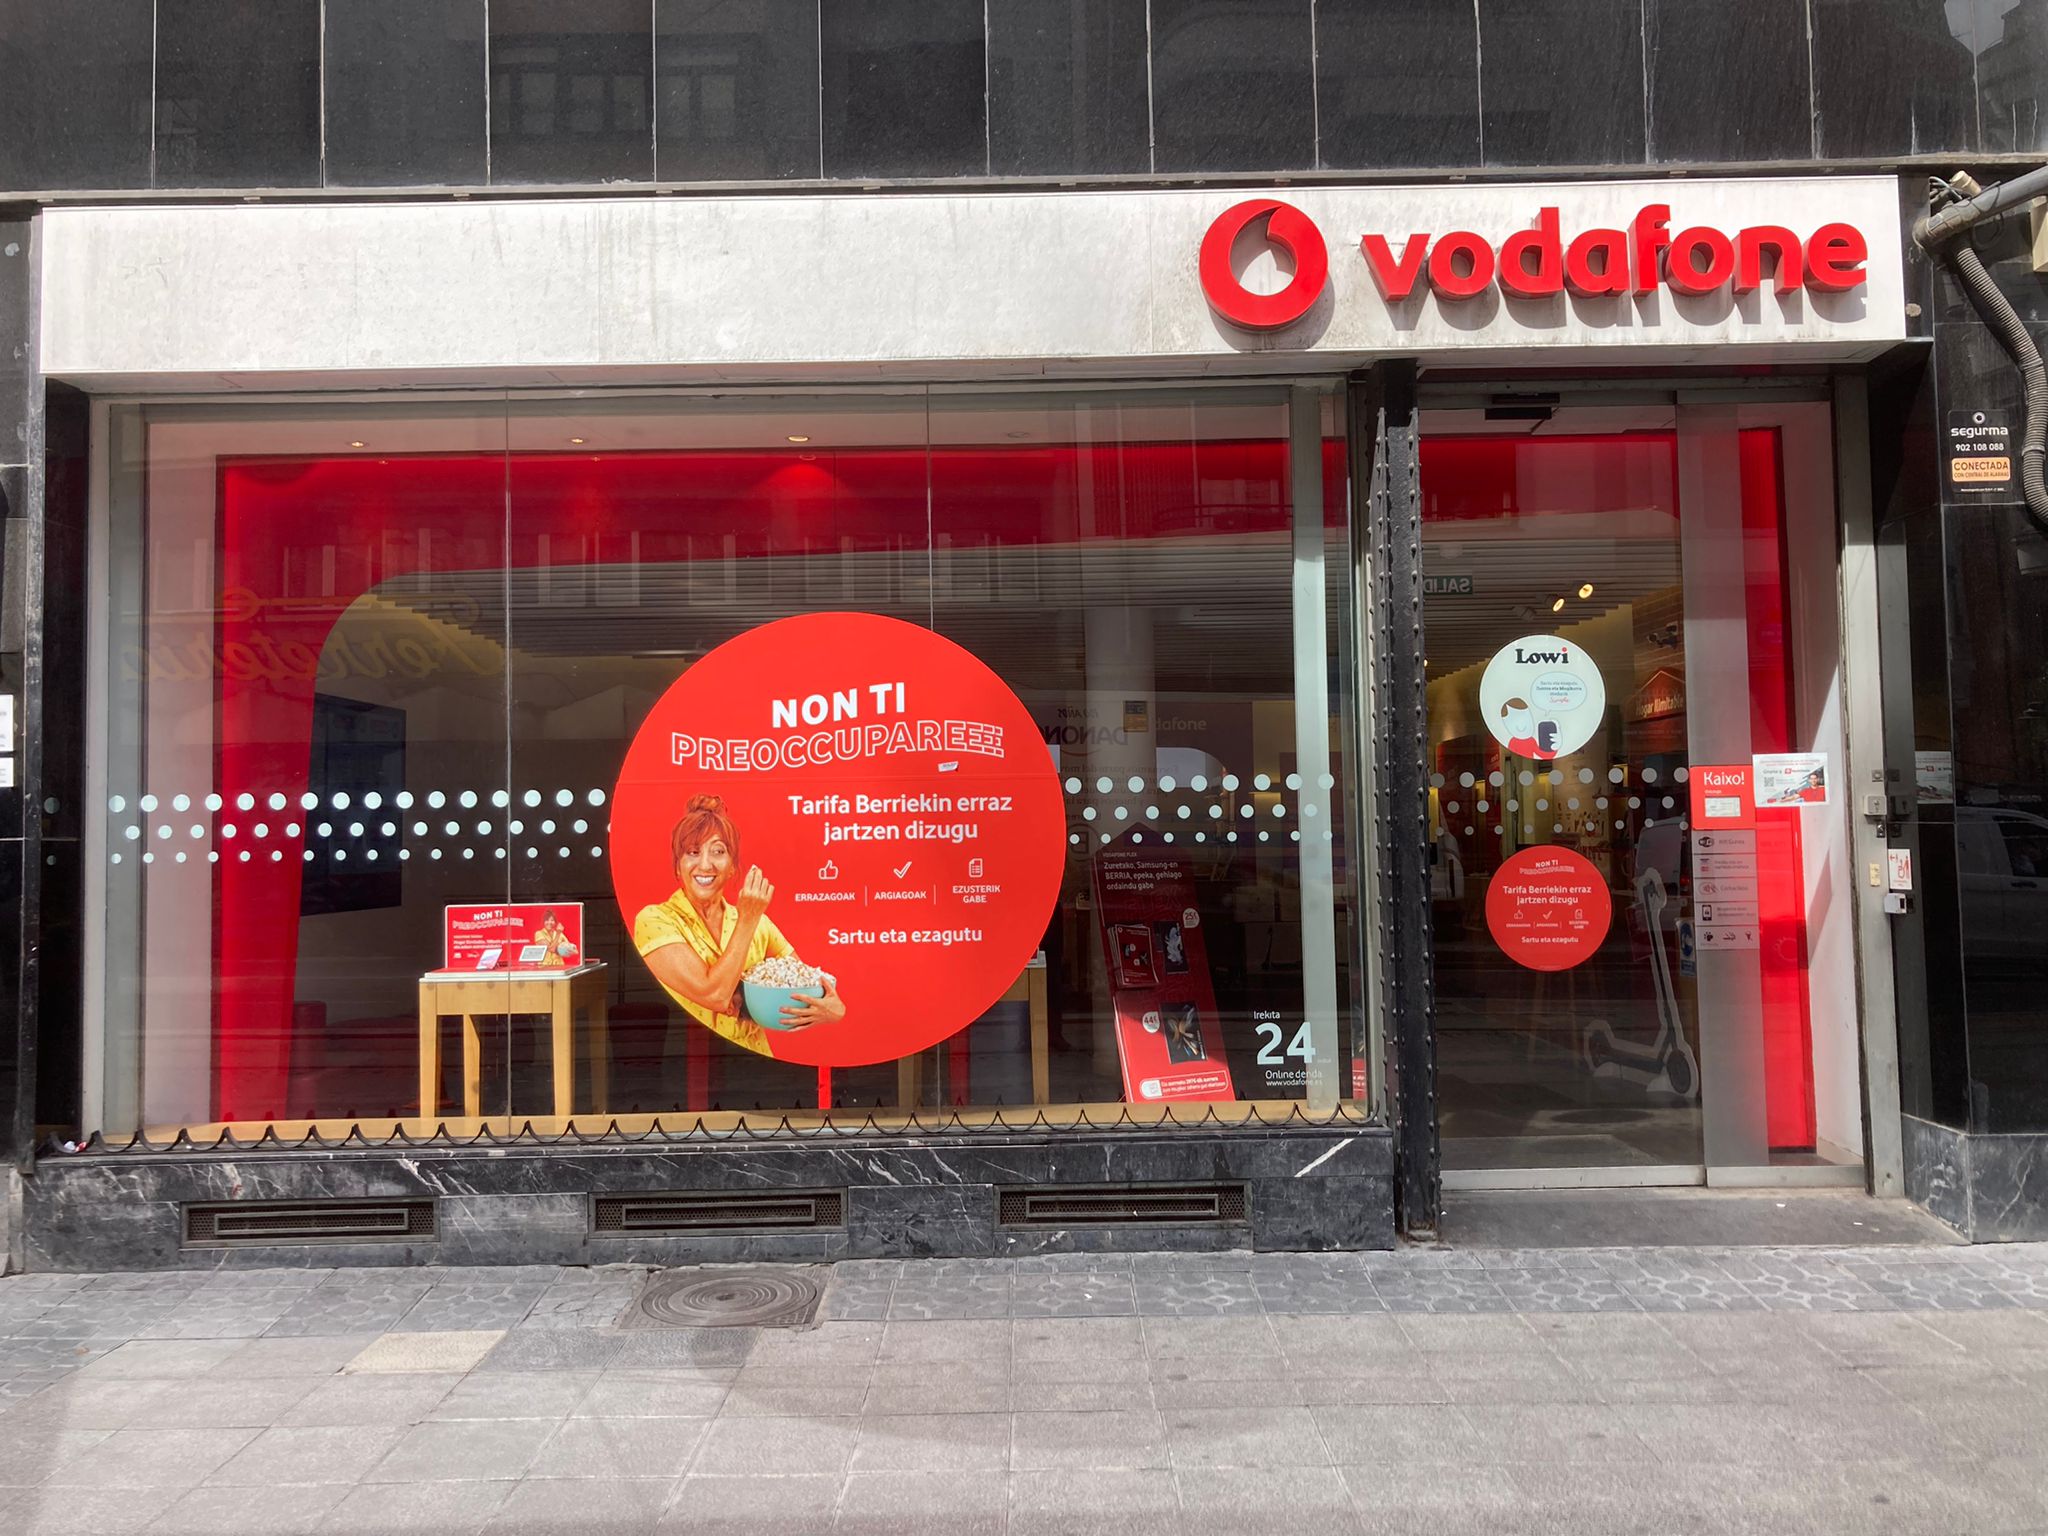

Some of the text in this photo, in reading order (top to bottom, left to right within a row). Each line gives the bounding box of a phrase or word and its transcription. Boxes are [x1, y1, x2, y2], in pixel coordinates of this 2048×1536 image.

[1361, 203, 1868, 300] vodafone
[1950, 426, 2009, 438] segurma
[1955, 442, 2004, 452] 902 108 088
[1953, 461, 2009, 471] CONECTADA
[1515, 646, 1569, 664] Lowi
[772, 682, 906, 728] NON TI
[1703, 771, 1745, 786] Kaixo!
[788, 793, 1013, 815] Tarifa Berriekin erraz
[823, 820, 979, 846] jartzen dizugu
[1155, 871, 1182, 880] gehiago
[952, 884, 1001, 894] EZUSTERIK
[1106, 882, 1154, 891] ordaindu gabe
[1503, 885, 1592, 894] Tarifa Berriekin erraz
[795, 891, 856, 902] ERRAZAGOAK
[874, 890, 927, 900] ARGIAGOAK
[962, 894, 987, 903] GABE
[1517, 895, 1578, 906] jartzen dizugu
[473, 909, 503, 921] NON TI
[828, 926, 983, 946] Sartu eta ezagutu
[1552, 936, 1579, 944] ezagutu
[1253, 1010, 1281, 1019] Irekita
[1255, 1021, 1316, 1065] 24
[1265, 1069, 1322, 1079] Online denda
